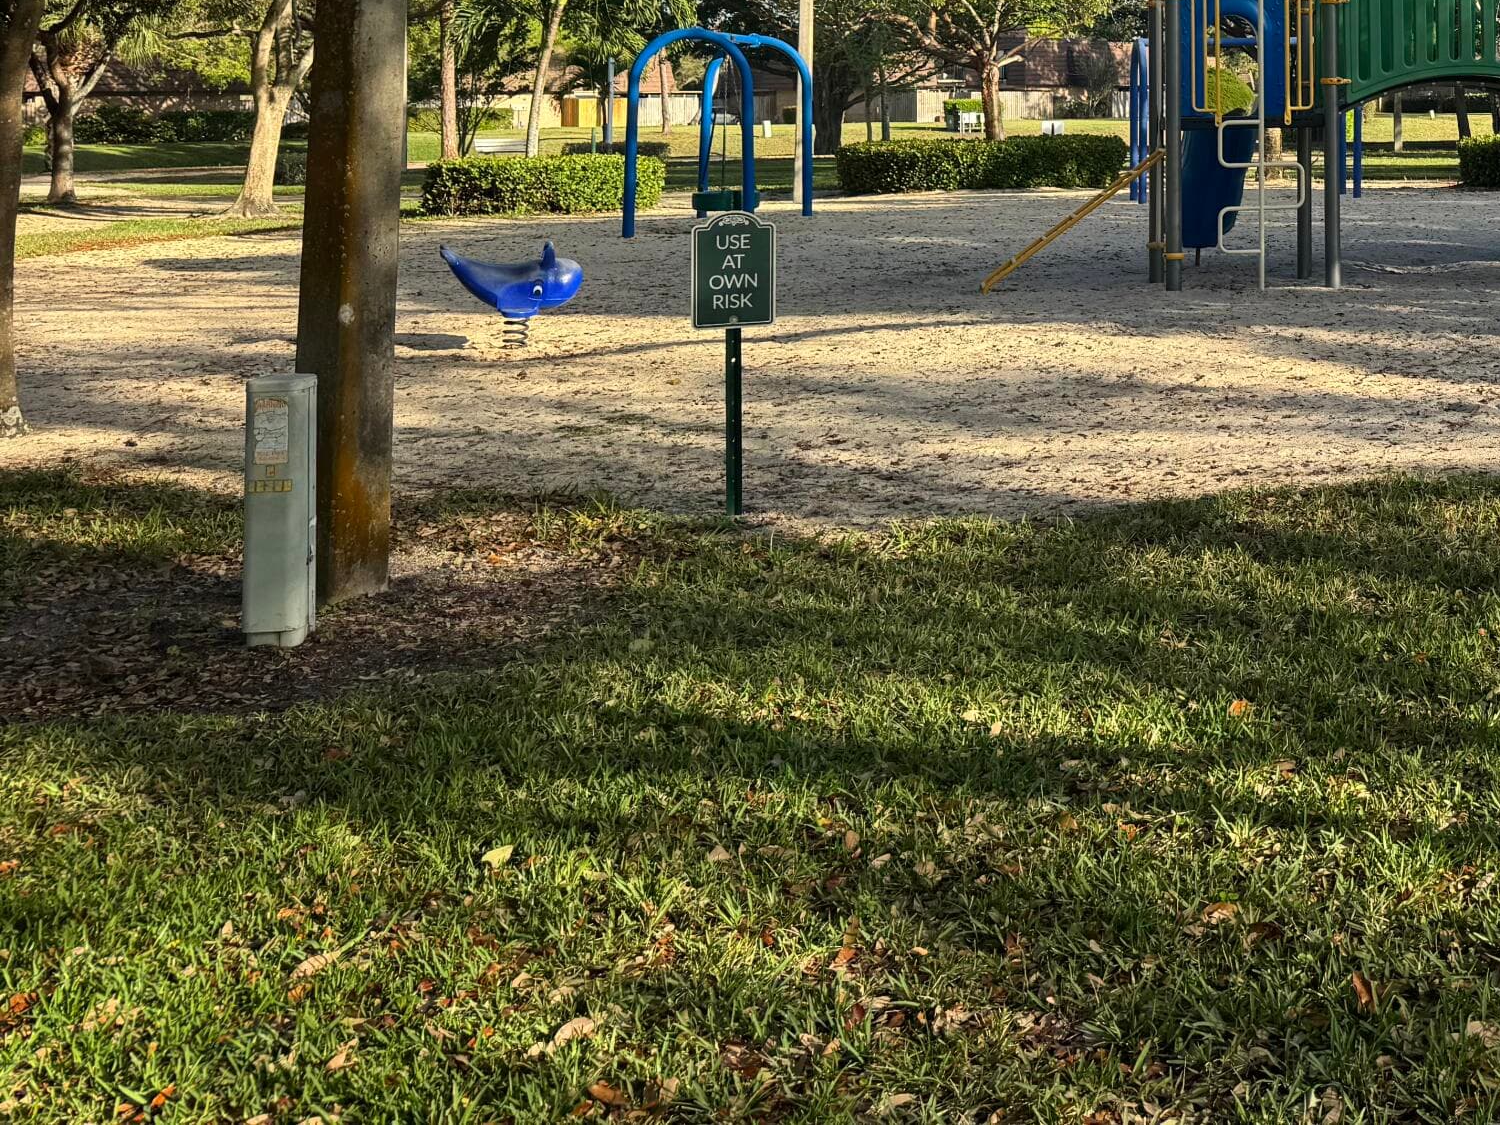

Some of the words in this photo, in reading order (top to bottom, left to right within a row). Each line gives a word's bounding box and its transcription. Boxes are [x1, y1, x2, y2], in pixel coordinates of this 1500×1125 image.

[716, 234, 751, 250] USE
[722, 255, 745, 269] AT
[709, 273, 758, 290] OWN
[713, 293, 753, 310] RISK
